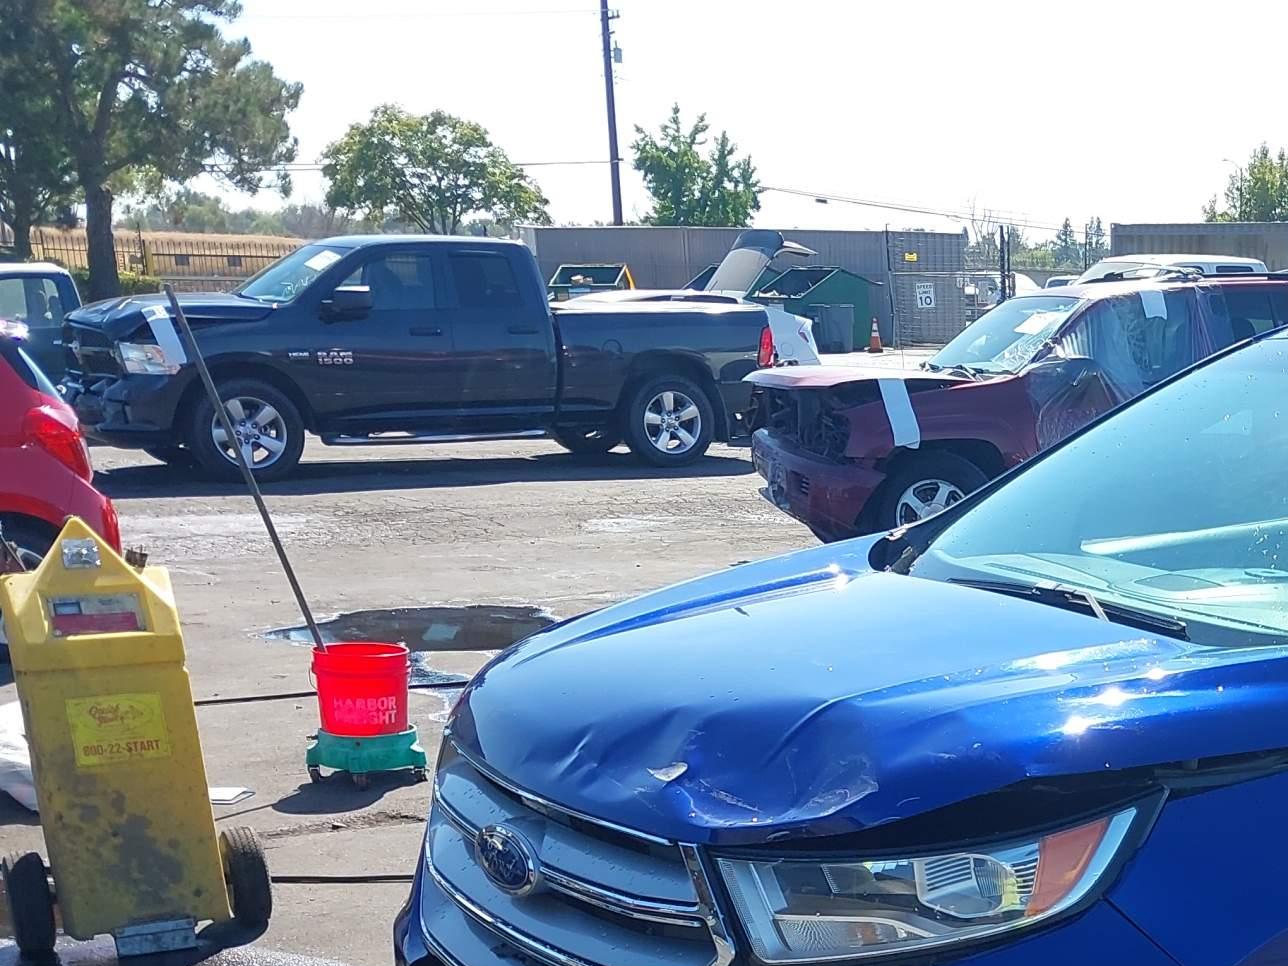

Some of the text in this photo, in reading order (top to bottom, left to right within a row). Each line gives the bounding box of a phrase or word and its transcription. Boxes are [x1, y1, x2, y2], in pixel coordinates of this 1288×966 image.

[919, 296, 932, 306] 10
[318, 357, 353, 365] 1500
[333, 696, 397, 710] HARBOR
[82, 739, 161, 757] 800-22-START
